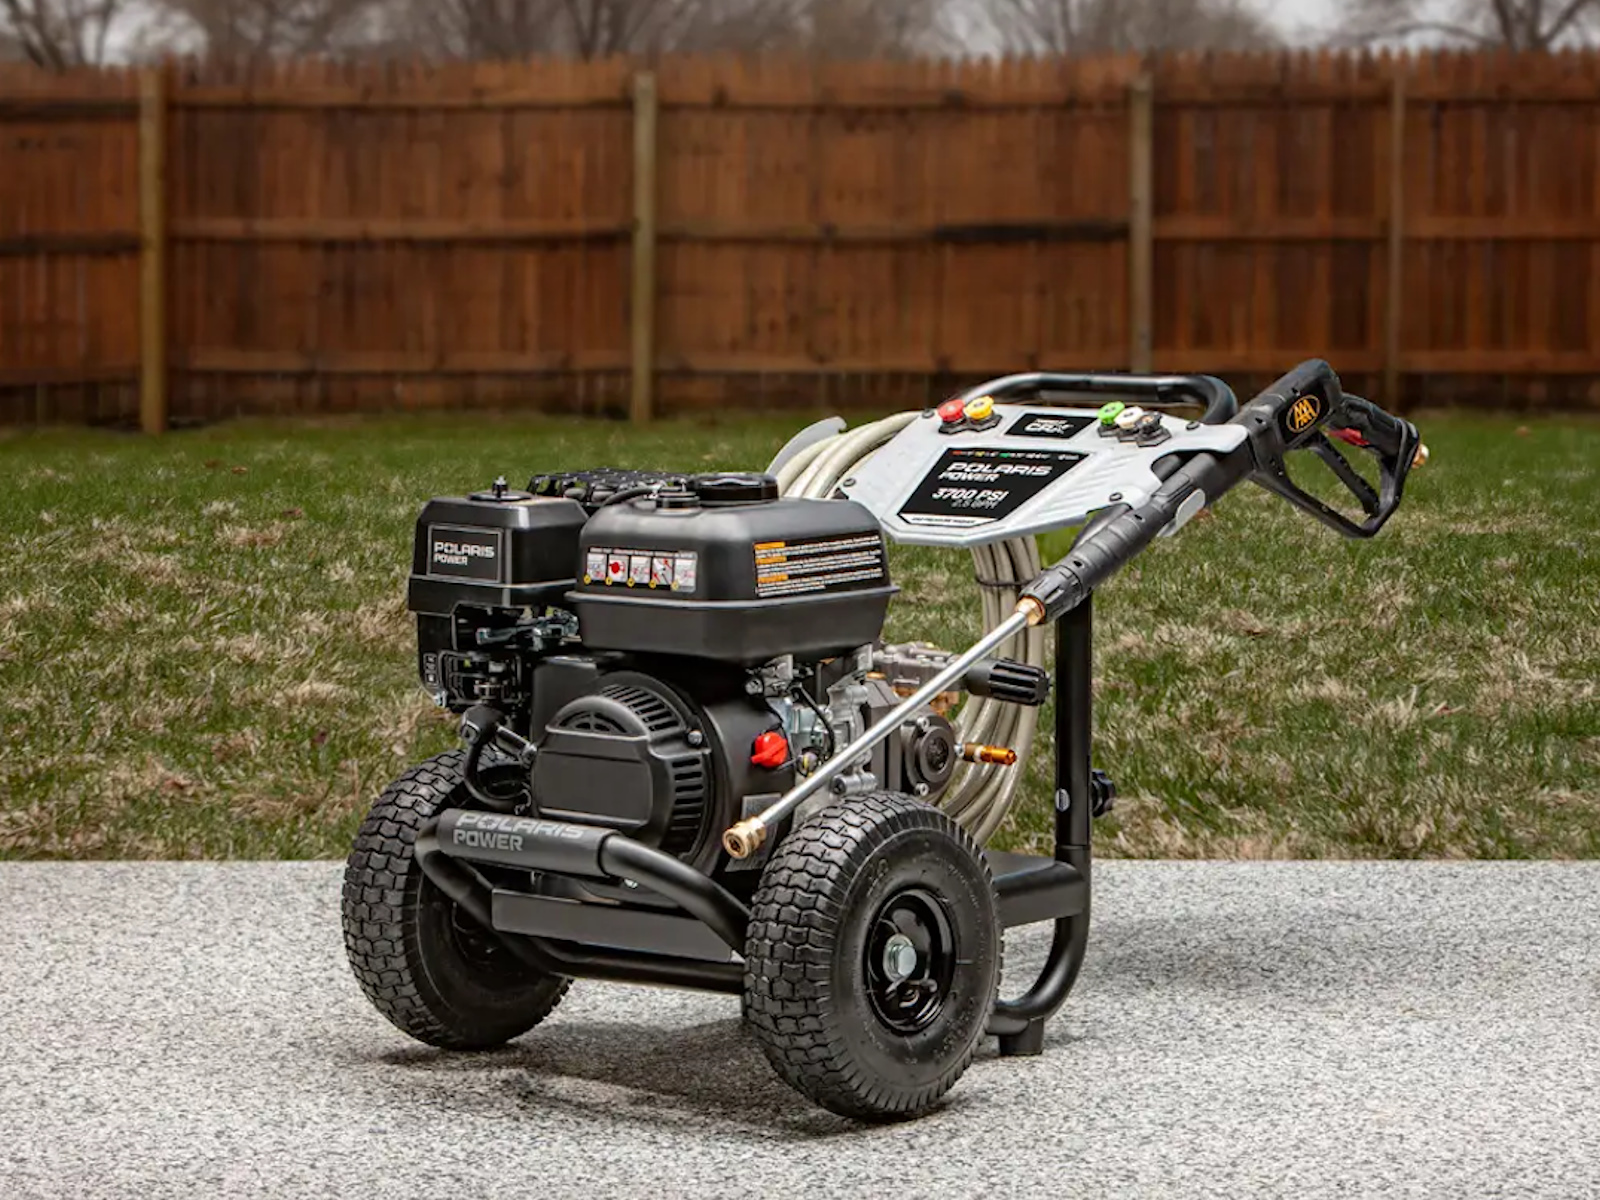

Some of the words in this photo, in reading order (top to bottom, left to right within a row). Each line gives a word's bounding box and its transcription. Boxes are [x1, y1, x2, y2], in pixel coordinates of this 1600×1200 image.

[947, 462, 1052, 476] POLARIS
[938, 471, 1000, 483] POWER
[932, 487, 977, 500] 3700
[975, 489, 1009, 502] PSI
[435, 542, 494, 558] POLARIS
[434, 553, 468, 565] POWER
[456, 812, 585, 839] POLARIS
[453, 829, 524, 851] POWER
